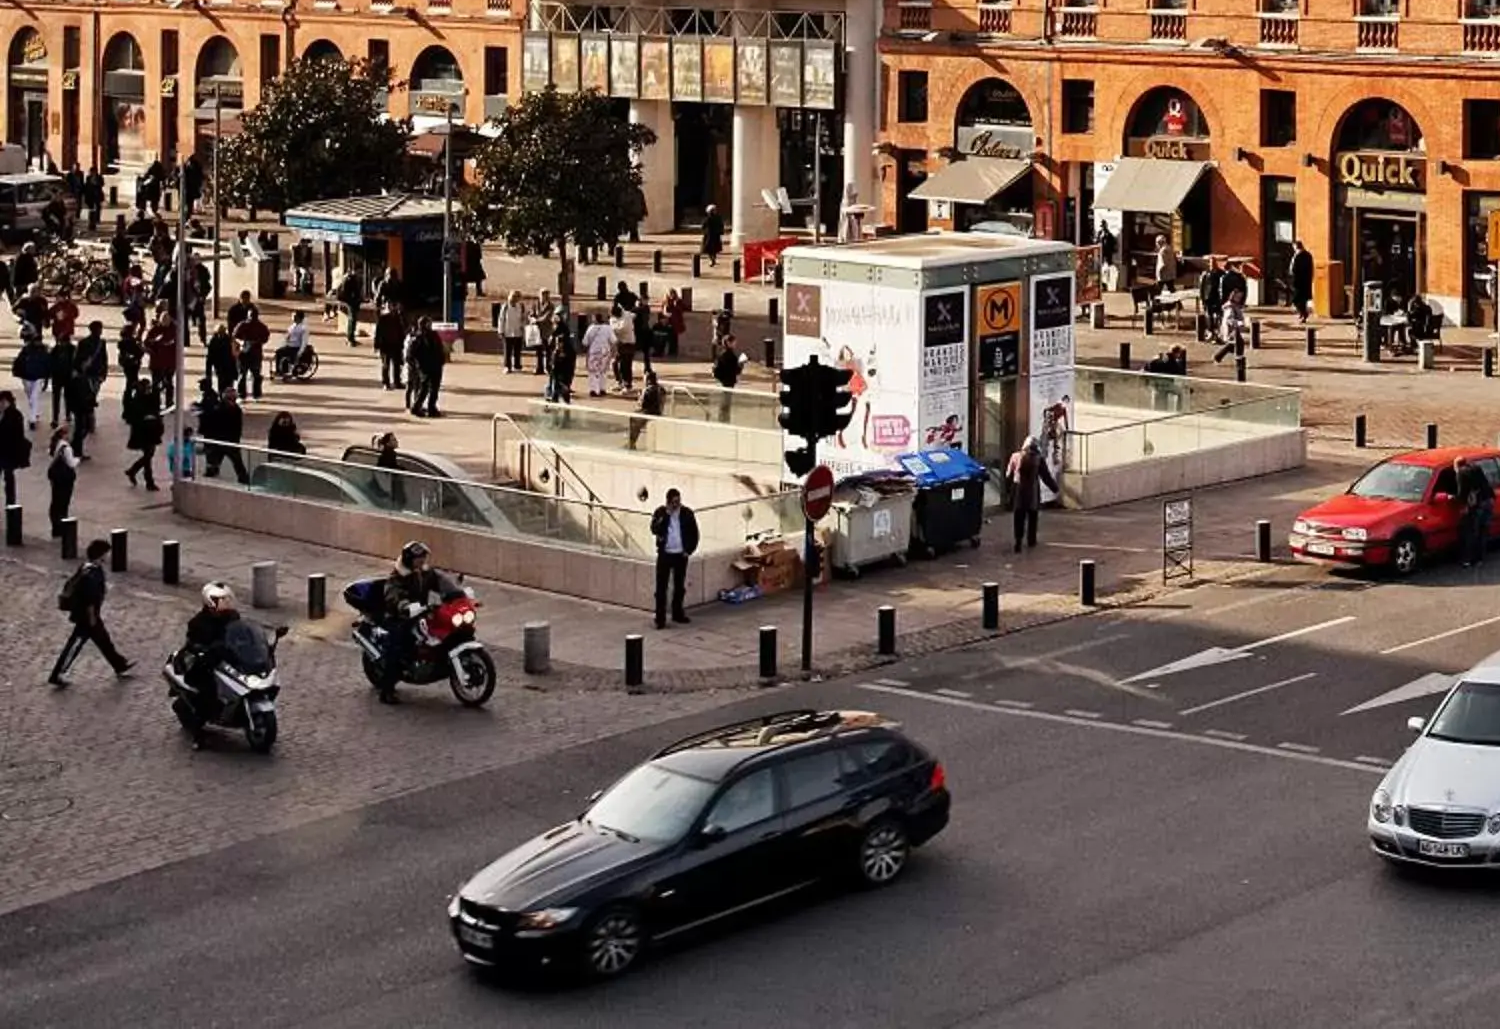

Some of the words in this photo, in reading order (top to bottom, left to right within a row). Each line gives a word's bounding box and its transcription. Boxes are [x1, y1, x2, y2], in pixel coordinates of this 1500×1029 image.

[1144, 138, 1188, 161] Quick
[1340, 154, 1416, 187] Quick
[990, 297, 1009, 322] M
